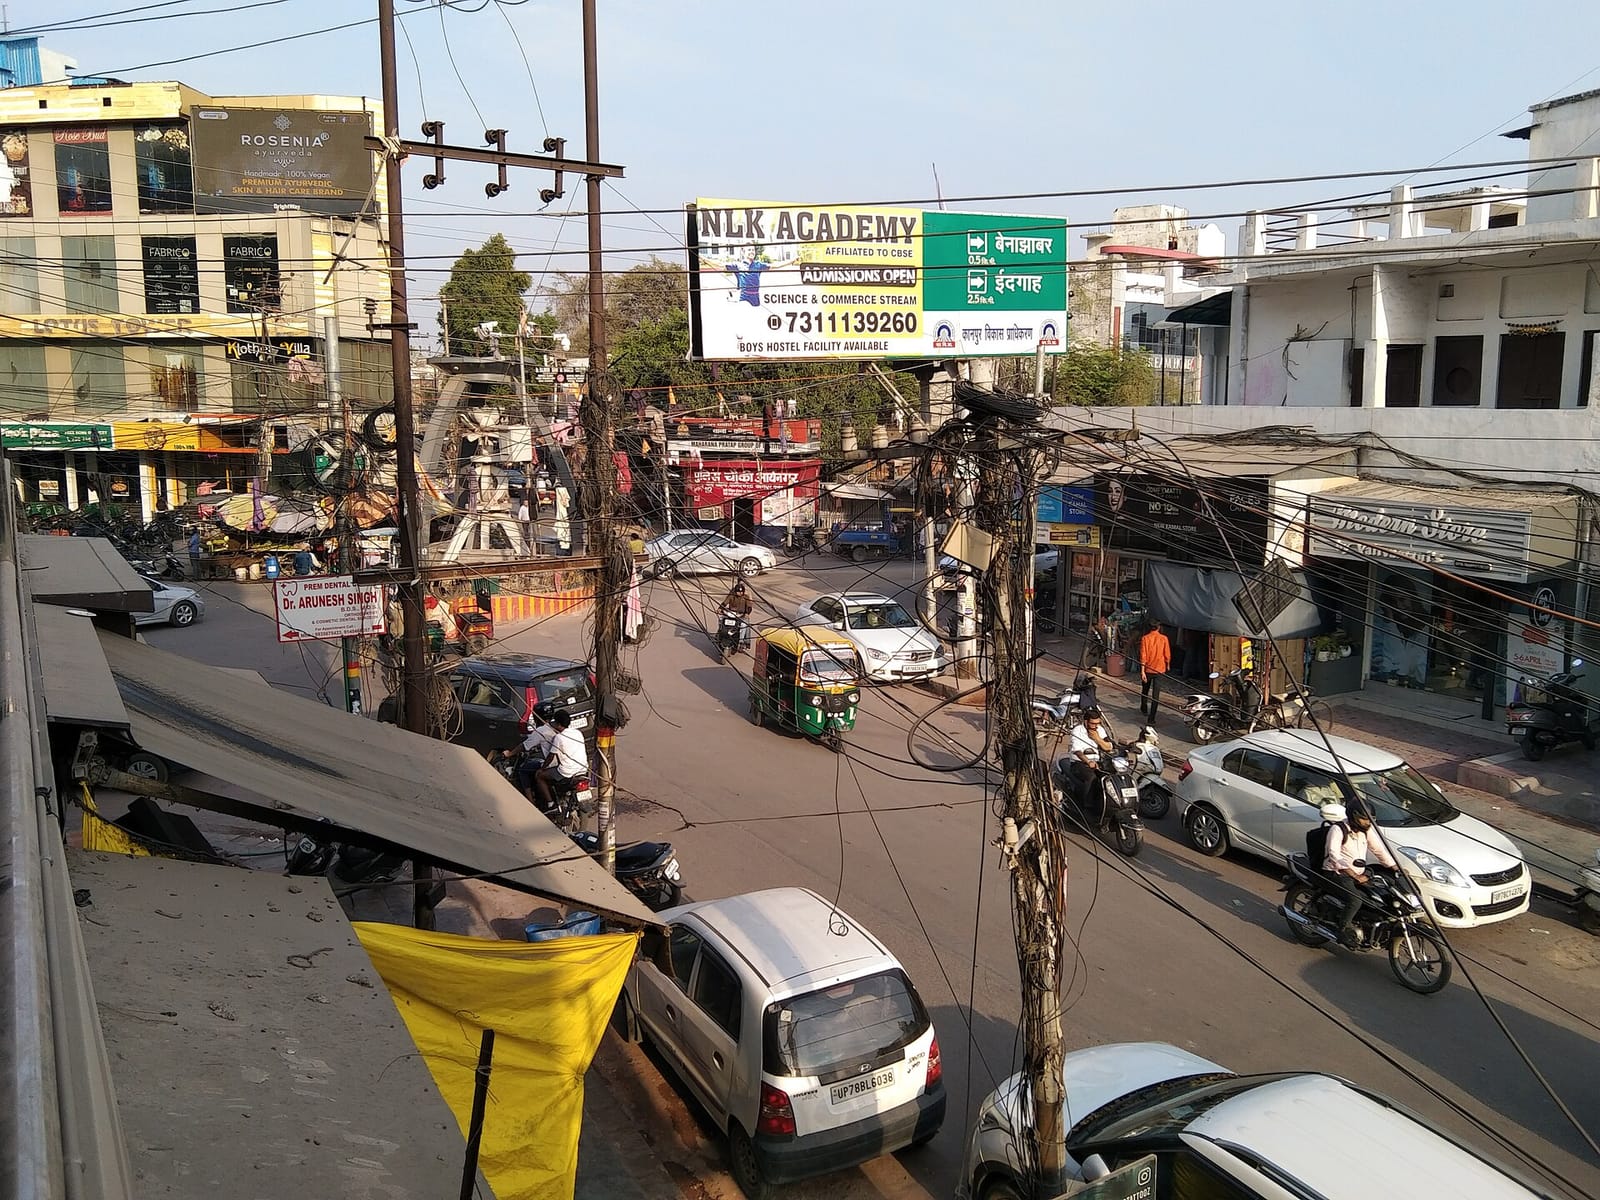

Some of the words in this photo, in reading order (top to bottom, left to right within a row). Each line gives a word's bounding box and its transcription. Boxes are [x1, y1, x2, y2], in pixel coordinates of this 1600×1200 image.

[241, 134, 324, 147] ROSENIA
[254, 148, 313, 157] ayurveda
[286, 171, 306, 179] 100%
[309, 172, 331, 180] Vegan
[242, 178, 282, 186] PREMIUM
[284, 180, 333, 188] AYURVEDIC
[232, 186, 253, 194] SKIN
[266, 187, 287, 195] HAIR
[289, 188, 311, 196] CARE
[313, 189, 344, 197] BRAND
[701, 207, 765, 239] NLK
[777, 211, 917, 245] ACADEMY
[995, 231, 1053, 254] बेनाझाबर
[230, 246, 272, 257] FABRICO
[825, 247, 874, 257] AFFILIATED
[878, 248, 888, 257] TO
[891, 248, 914, 258] CBSE
[968, 256, 981, 264] 0.5
[802, 265, 881, 284] ADMISSIONS
[883, 268, 916, 285] OPEN
[994, 269, 1042, 294] ईदगाह
[764, 293, 808, 304] SCIENCE
[810, 294, 817, 304] &
[821, 294, 877, 305] COMMERCE
[879, 295, 918, 306] STREAM
[967, 295, 980, 304] 2.5
[785, 311, 918, 333] 7311139260
[962, 328, 983, 345] कानपुर
[985, 323, 1004, 341] विकास
[280, 342, 311, 355] Villa
[739, 341, 764, 352] BOYS
[766, 341, 797, 352] HOSTEL
[799, 341, 842, 352] FACILITY
[843, 340, 889, 351] AVAILABLE
[1421, 508, 1488, 544] Store
[304, 582, 323, 591] PREM
[324, 581, 351, 590] DENTAL
[283, 598, 296, 610] Dr.
[298, 593, 345, 609] ARUNESH
[347, 591, 378, 605] SINGH
[837, 1072, 894, 1100] UP78BL6038
